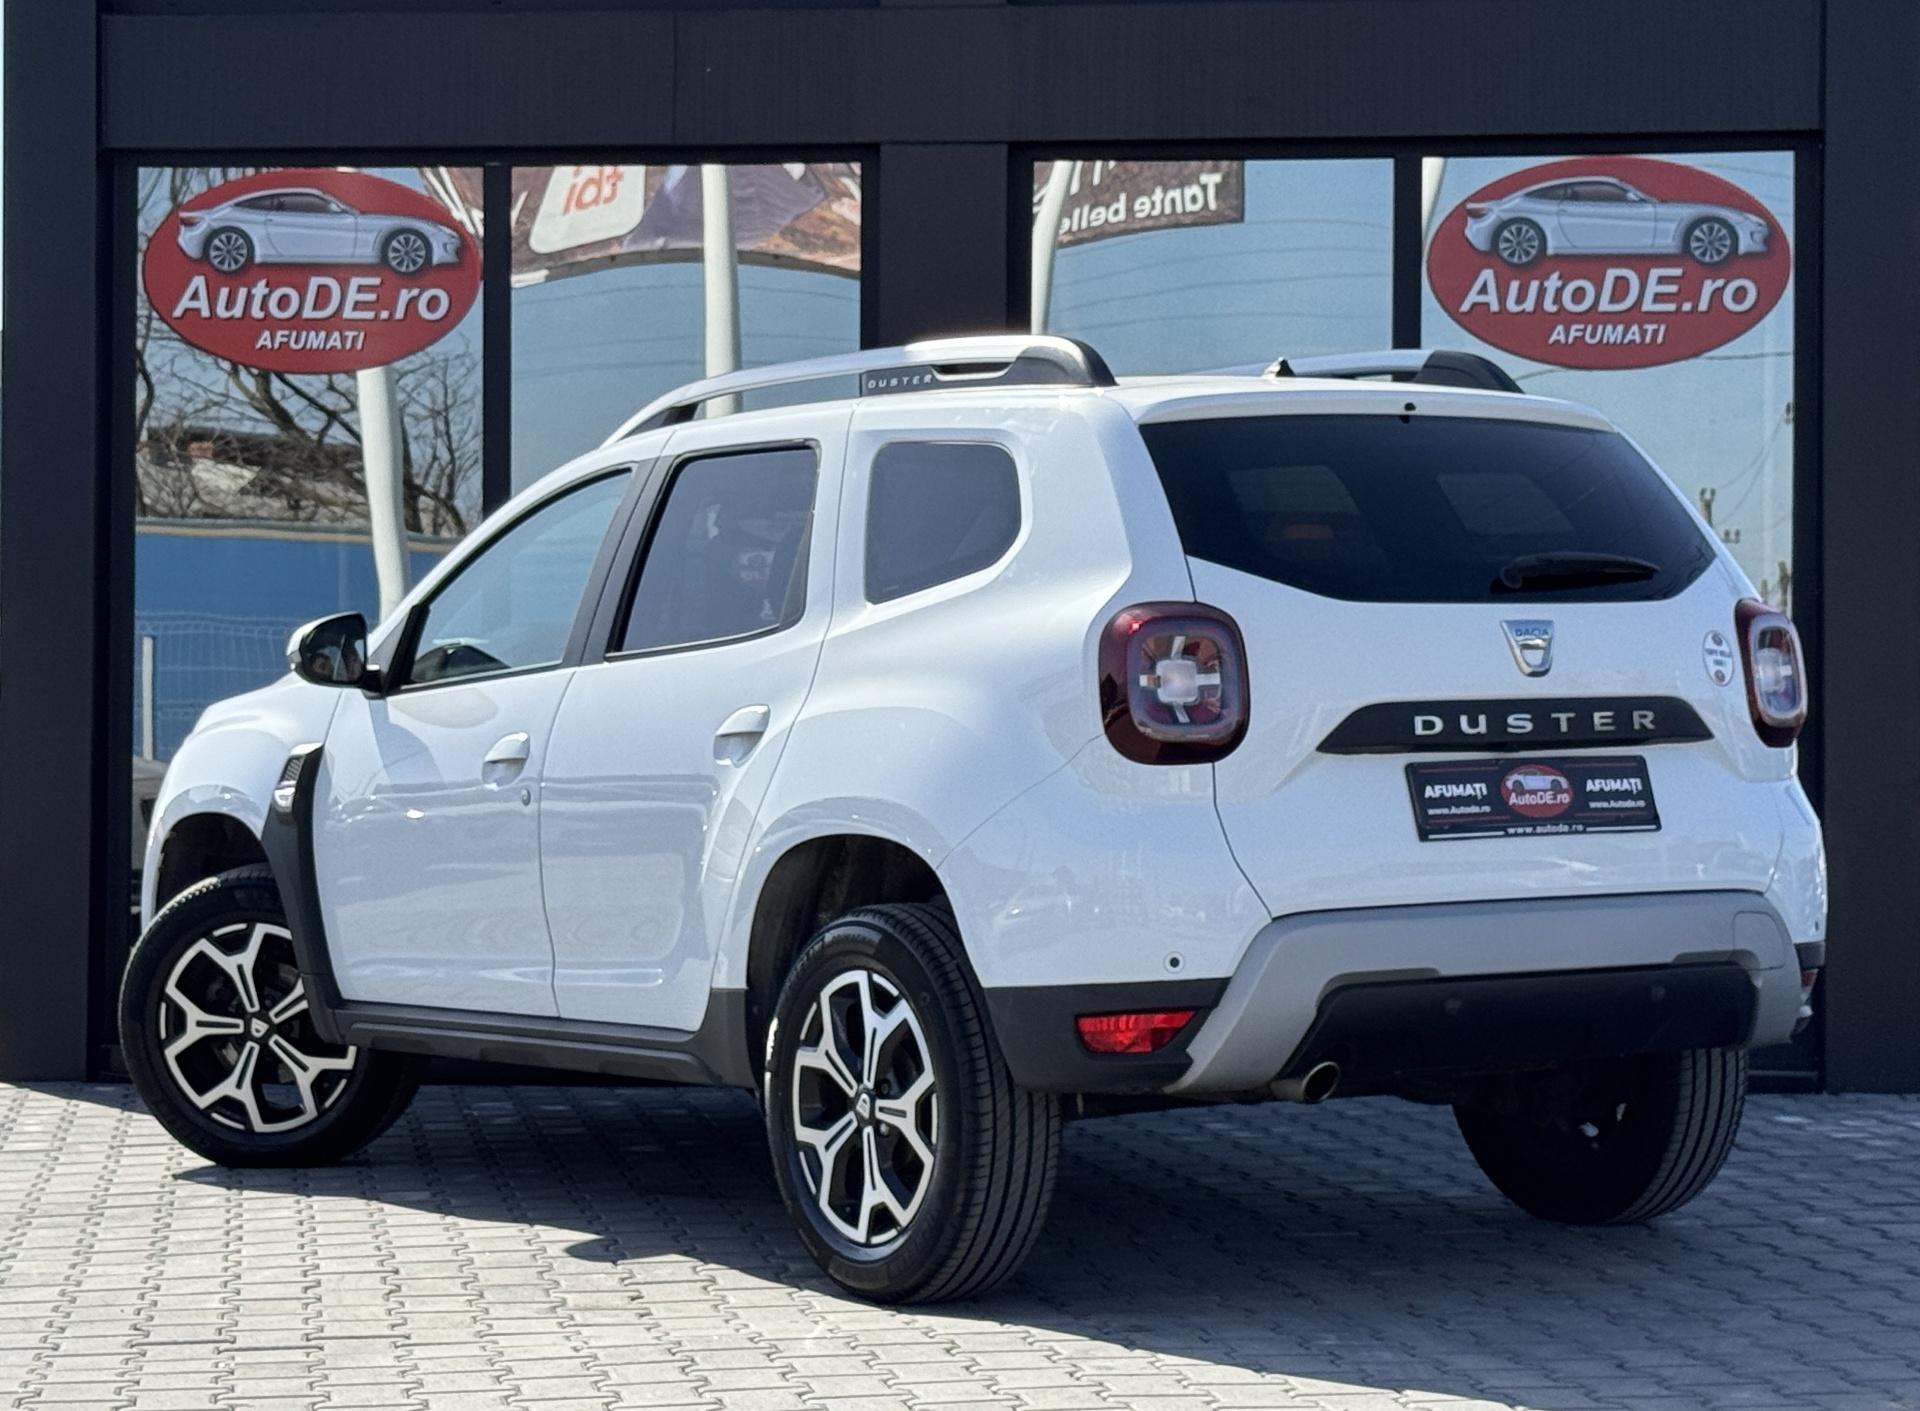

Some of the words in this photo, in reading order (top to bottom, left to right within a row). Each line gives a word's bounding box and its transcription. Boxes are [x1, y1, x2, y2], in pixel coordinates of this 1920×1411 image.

[171, 274, 450, 321] AutoDE.ro
[1458, 267, 1758, 314] AutoDE.ro
[255, 330, 366, 351] AFUMATI
[1548, 323, 1666, 345] AFUMATI
[867, 374, 934, 390] DUSTER
[1413, 709, 1656, 736] DUSTER
[1508, 790, 1570, 806] AutoDE.ro
